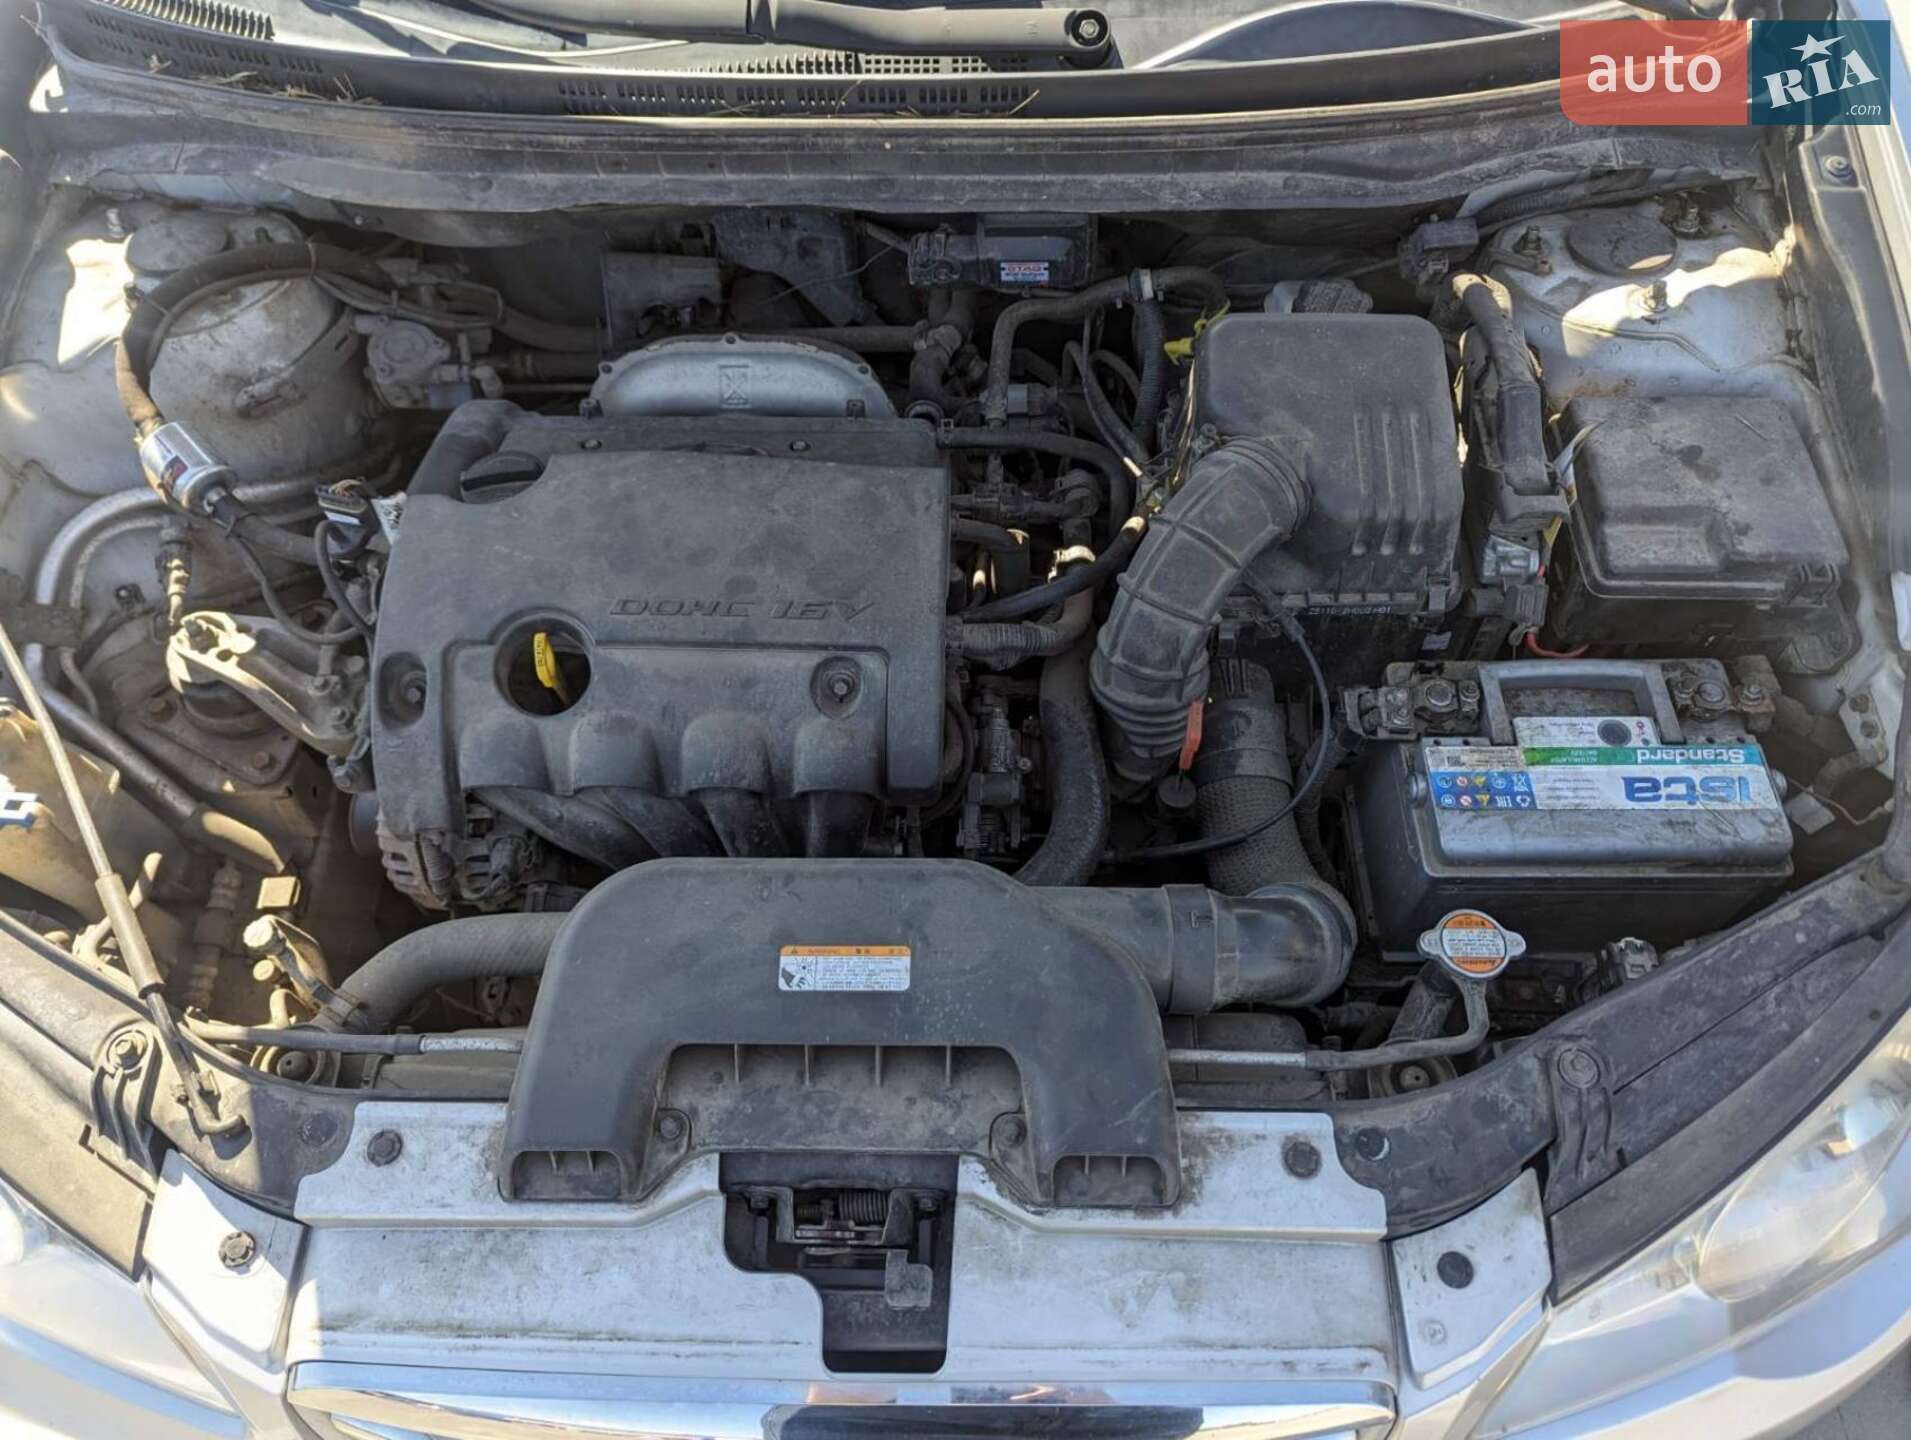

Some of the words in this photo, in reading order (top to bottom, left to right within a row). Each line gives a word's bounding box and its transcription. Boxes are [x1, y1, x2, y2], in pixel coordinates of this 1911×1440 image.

[610, 599, 756, 617] DOHC
[770, 600, 877, 621] 16V
[1636, 748, 1745, 764] Standard
